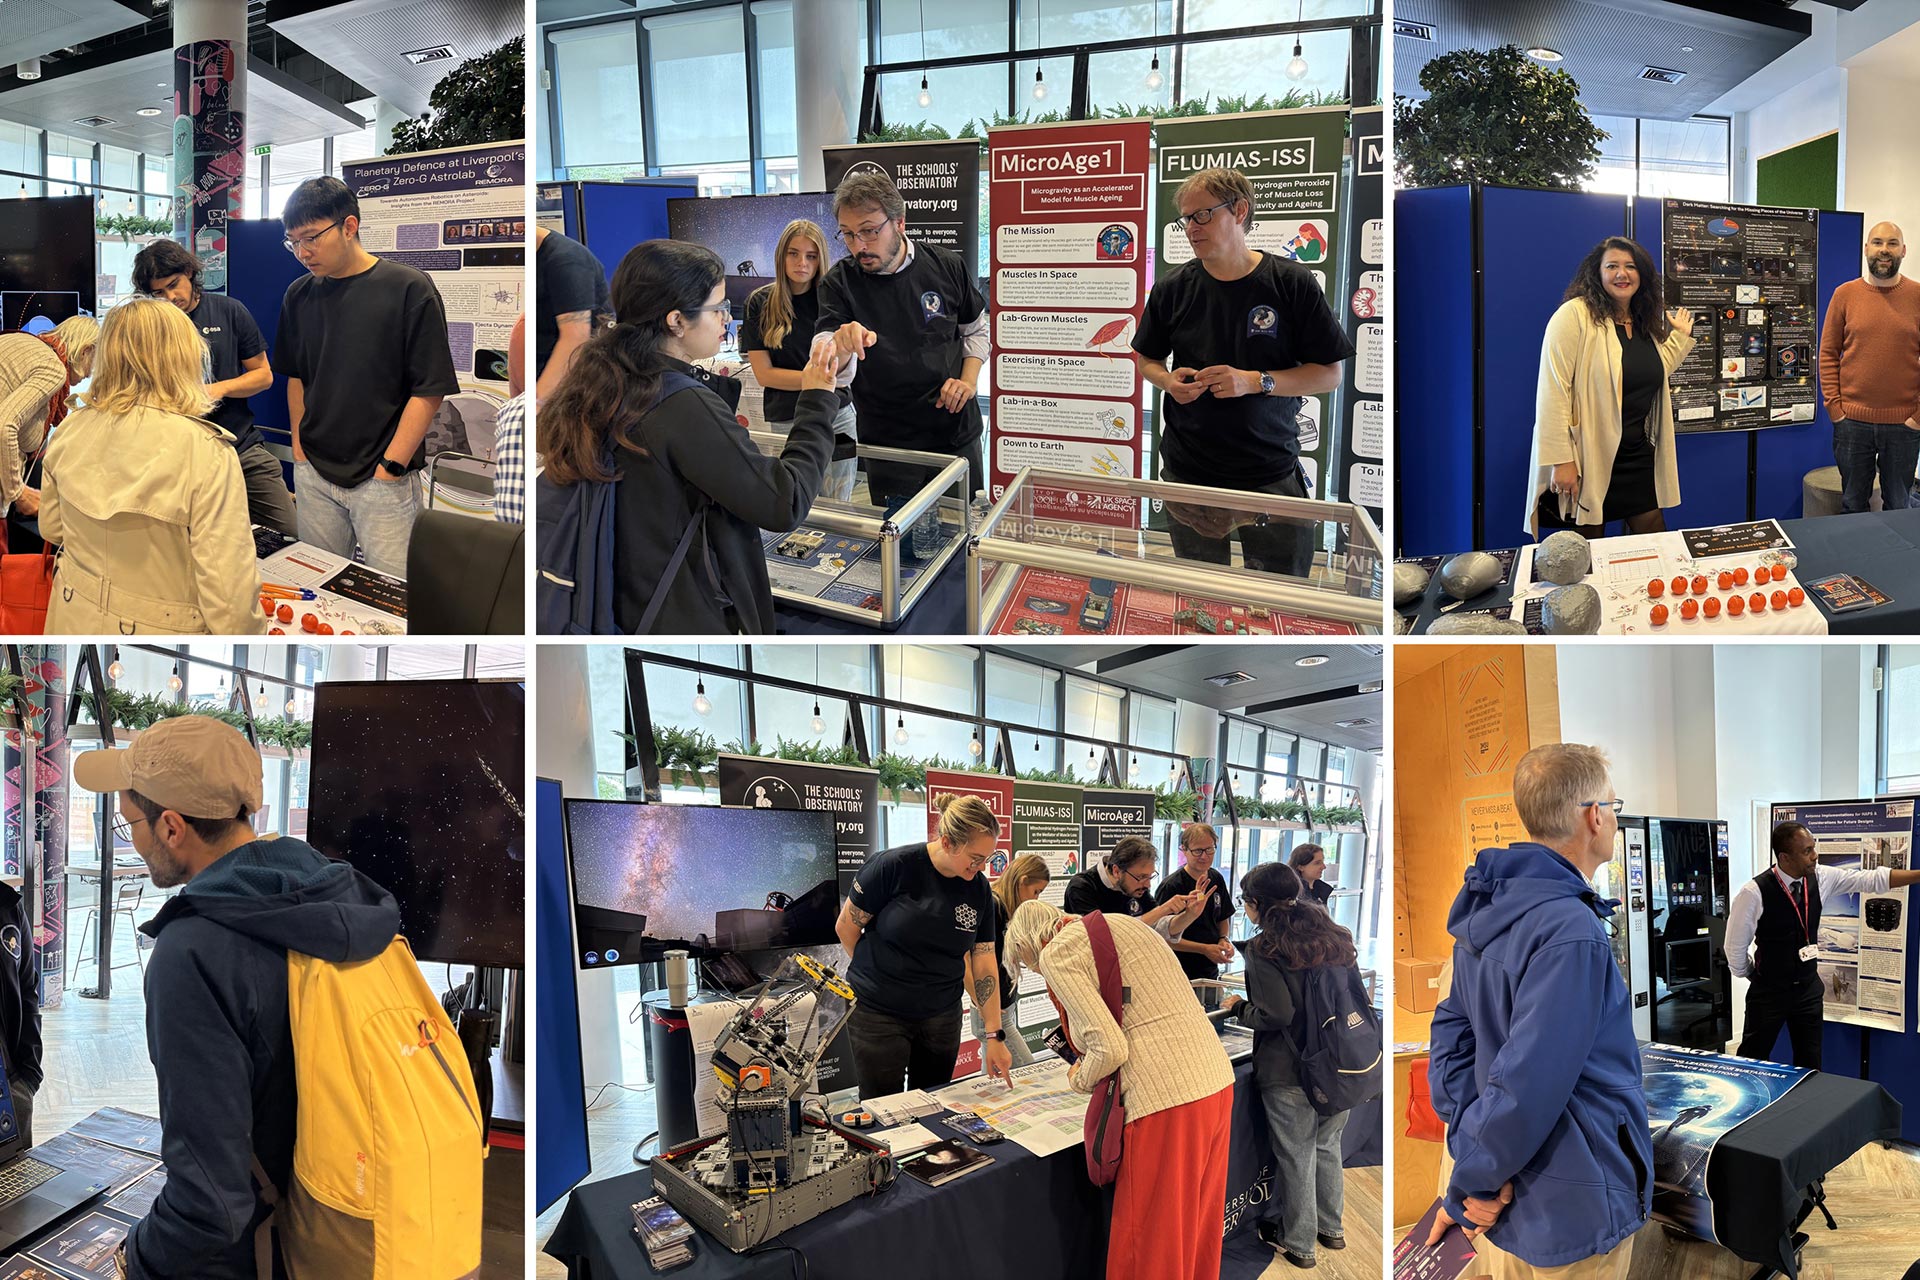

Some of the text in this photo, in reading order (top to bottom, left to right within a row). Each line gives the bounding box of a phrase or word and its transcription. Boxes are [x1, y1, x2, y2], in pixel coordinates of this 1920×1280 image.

[355, 152, 524, 178] Planetary Defence at Liverpool's
[1001, 149, 1112, 174] MicroAge1
[1167, 148, 1306, 171] FLUMIAS-ISS
[897, 162, 959, 176] THE SCHOOLS'
[394, 170, 476, 186] Zero-G Astrolab
[475, 177, 514, 186] REMORA
[897, 176, 958, 190] OBSERVATORY
[1254, 179, 1330, 189] Hydrogen Peroxide
[1031, 186, 1072, 195] Microgravity
[1274, 190, 1303, 198] Muscle
[904, 199, 958, 212] rvatory.org
[1295, 200, 1322, 209] Ageing
[1021, 226, 1055, 234] Mission
[1050, 271, 1078, 280] Space
[1002, 314, 1088, 324] Lab-Grown Muscles
[1002, 356, 1046, 366] Exercising
[1058, 358, 1085, 367] Space
[1002, 397, 1058, 408] Lab-in-a-Box
[1003, 439, 1027, 448] Down
[1041, 441, 1064, 450] Earth
[1361, 466, 1374, 475] To
[1102, 503, 1133, 512] AGENCY
[804, 784, 862, 800] THE SCHOOLS'
[805, 798, 863, 812] OBSERVATORY
[1016, 805, 1071, 818] FLUMIAS-ISS
[1087, 809, 1142, 824] MicroAge 2
[836, 822, 864, 834] ry.org
[1644, 1054, 1684, 1064] NURTURING
[1685, 1060, 1717, 1068] LEADERS
[1735, 1068, 1788, 1078] SUSTAINABLE
[1699, 1068, 1740, 1077] SOLUTIONS
